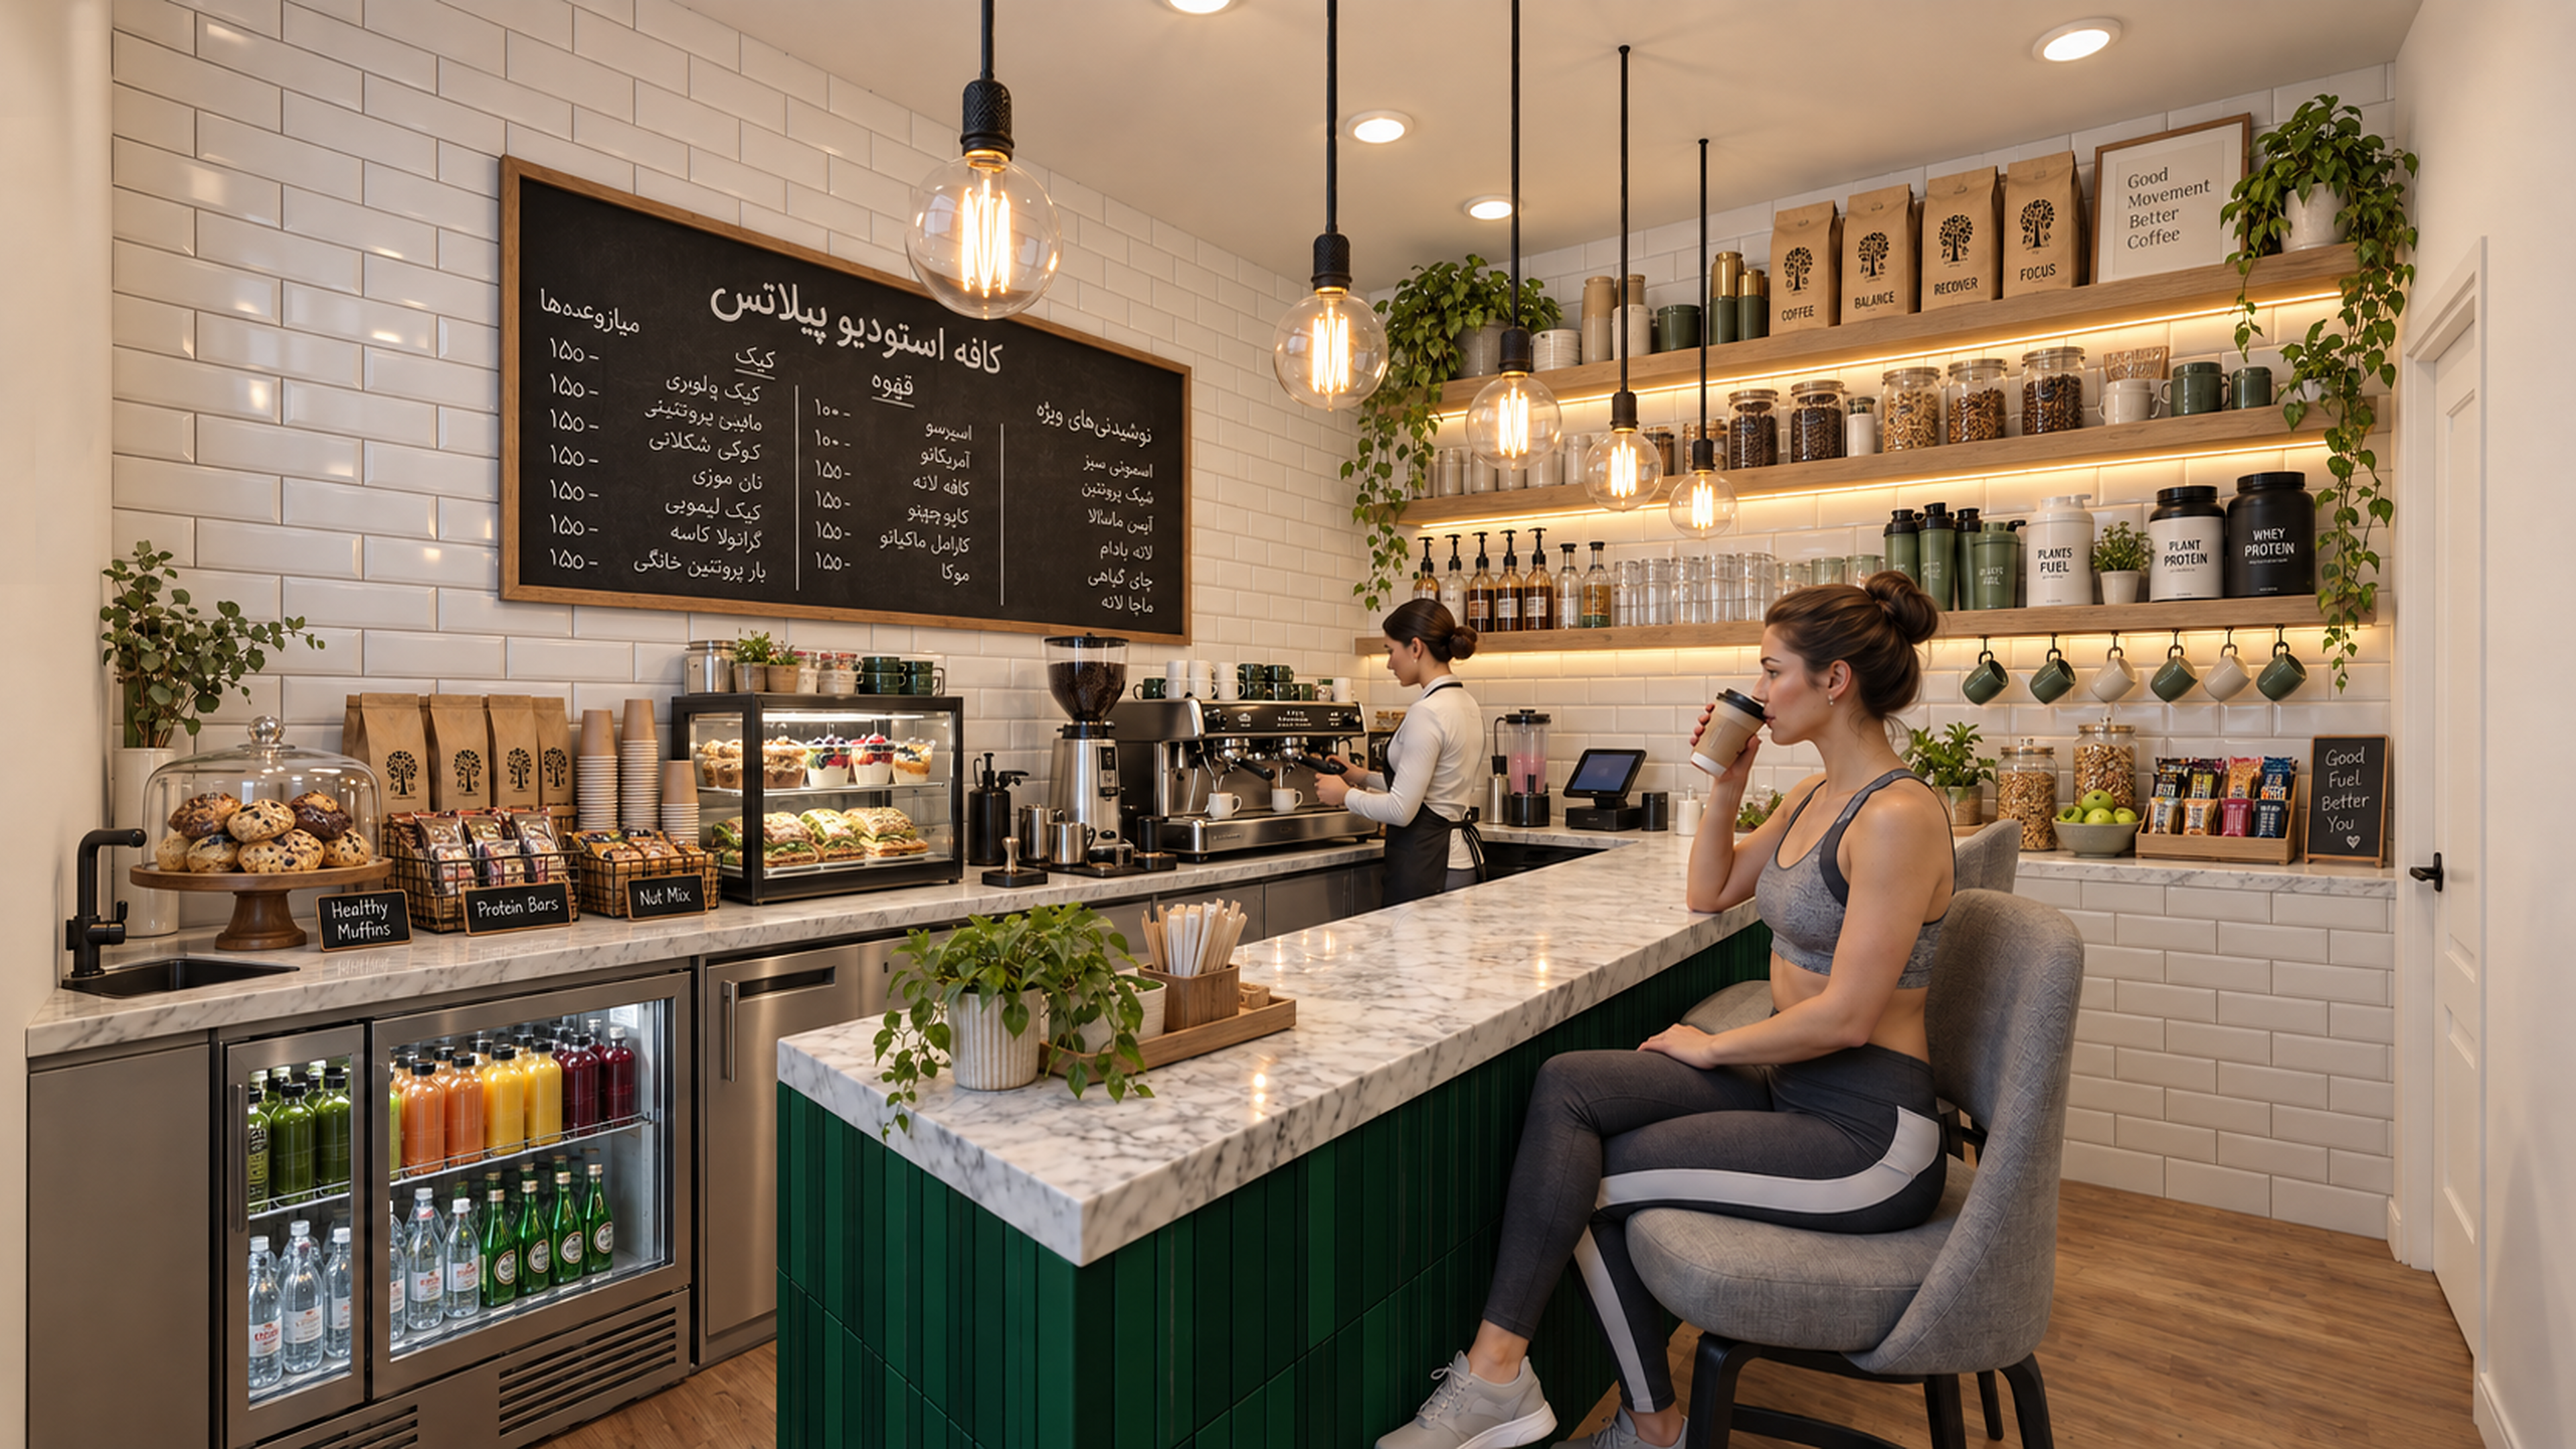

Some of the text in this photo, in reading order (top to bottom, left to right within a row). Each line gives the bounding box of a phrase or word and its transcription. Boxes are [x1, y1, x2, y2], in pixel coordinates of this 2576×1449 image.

[2127, 166, 2168, 189] Good
[2127, 178, 2211, 209] Movement
[2129, 208, 2180, 229] Better
[2127, 228, 2181, 250] Coffee
[2020, 263, 2056, 281] FOCUS
[1934, 276, 1978, 295] RECOVER
[1854, 290, 1894, 309] BALANCE
[1782, 305, 1814, 321] COFFEE
[710, 282, 1003, 374] کافه استودیو پیلاتس
[735, 347, 775, 373] کیک
[724, 382, 761, 406] کیک
[692, 468, 763, 493] نان موزی
[724, 502, 761, 525] کیک
[670, 524, 762, 553] گرانولا کاسه
[2253, 528, 2286, 541] WHEY
[2169, 539, 2201, 551] PLANT
[2244, 542, 2294, 557] PROTEIN
[2040, 561, 2070, 573] FUEL
[2164, 553, 2208, 566] PROTEIN
[747, 561, 766, 583] بار
[942, 563, 969, 586] موکا
[2325, 746, 2365, 766] Good
[2328, 769, 2361, 788] Fuel
[2322, 794, 2369, 812] Better
[2326, 815, 2355, 833] You
[639, 887, 691, 906] Nut Mix
[331, 898, 388, 920] Healthy
[476, 896, 559, 918] Protein Bars
[337, 920, 391, 940] Muffins
